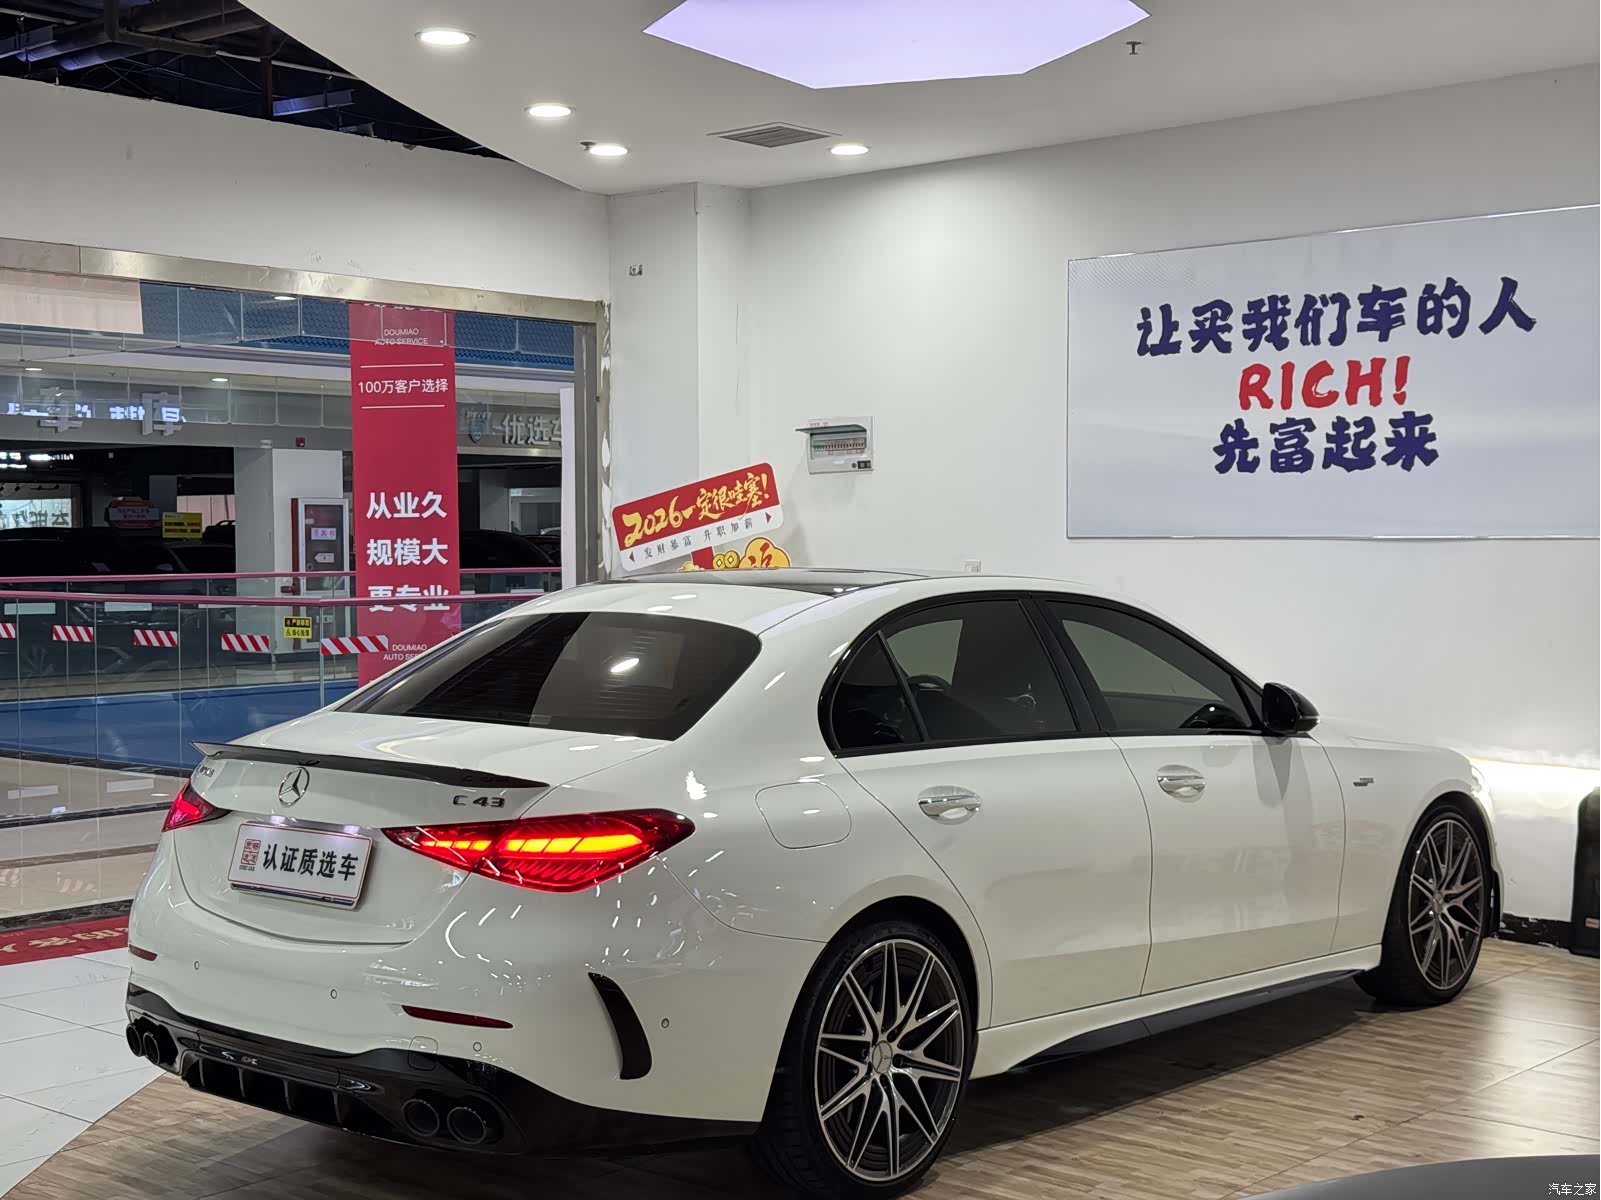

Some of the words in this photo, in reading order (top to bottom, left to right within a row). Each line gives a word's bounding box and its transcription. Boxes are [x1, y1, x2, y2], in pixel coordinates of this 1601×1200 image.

[383, 327, 420, 337] DOUMIAO
[1136, 276, 1537, 358] 让买我们车的人
[396, 337, 429, 346] SERVICE
[358, 377, 450, 395] 100万客户选择
[1237, 355, 1411, 411] RICH!
[1212, 410, 1440, 475] 先富起来
[366, 490, 448, 521] 从业久
[366, 536, 449, 567] 规模大
[644, 534, 692, 560] 发财暴富
[703, 517, 755, 542] 升职加薪
[368, 584, 451, 613] 更专业
[383, 653, 405, 661] AUTO
[392, 643, 428, 652] DOUMIAO
[452, 794, 468, 807] C
[472, 796, 506, 809] 43
[262, 843, 360, 882] 认证质选车
